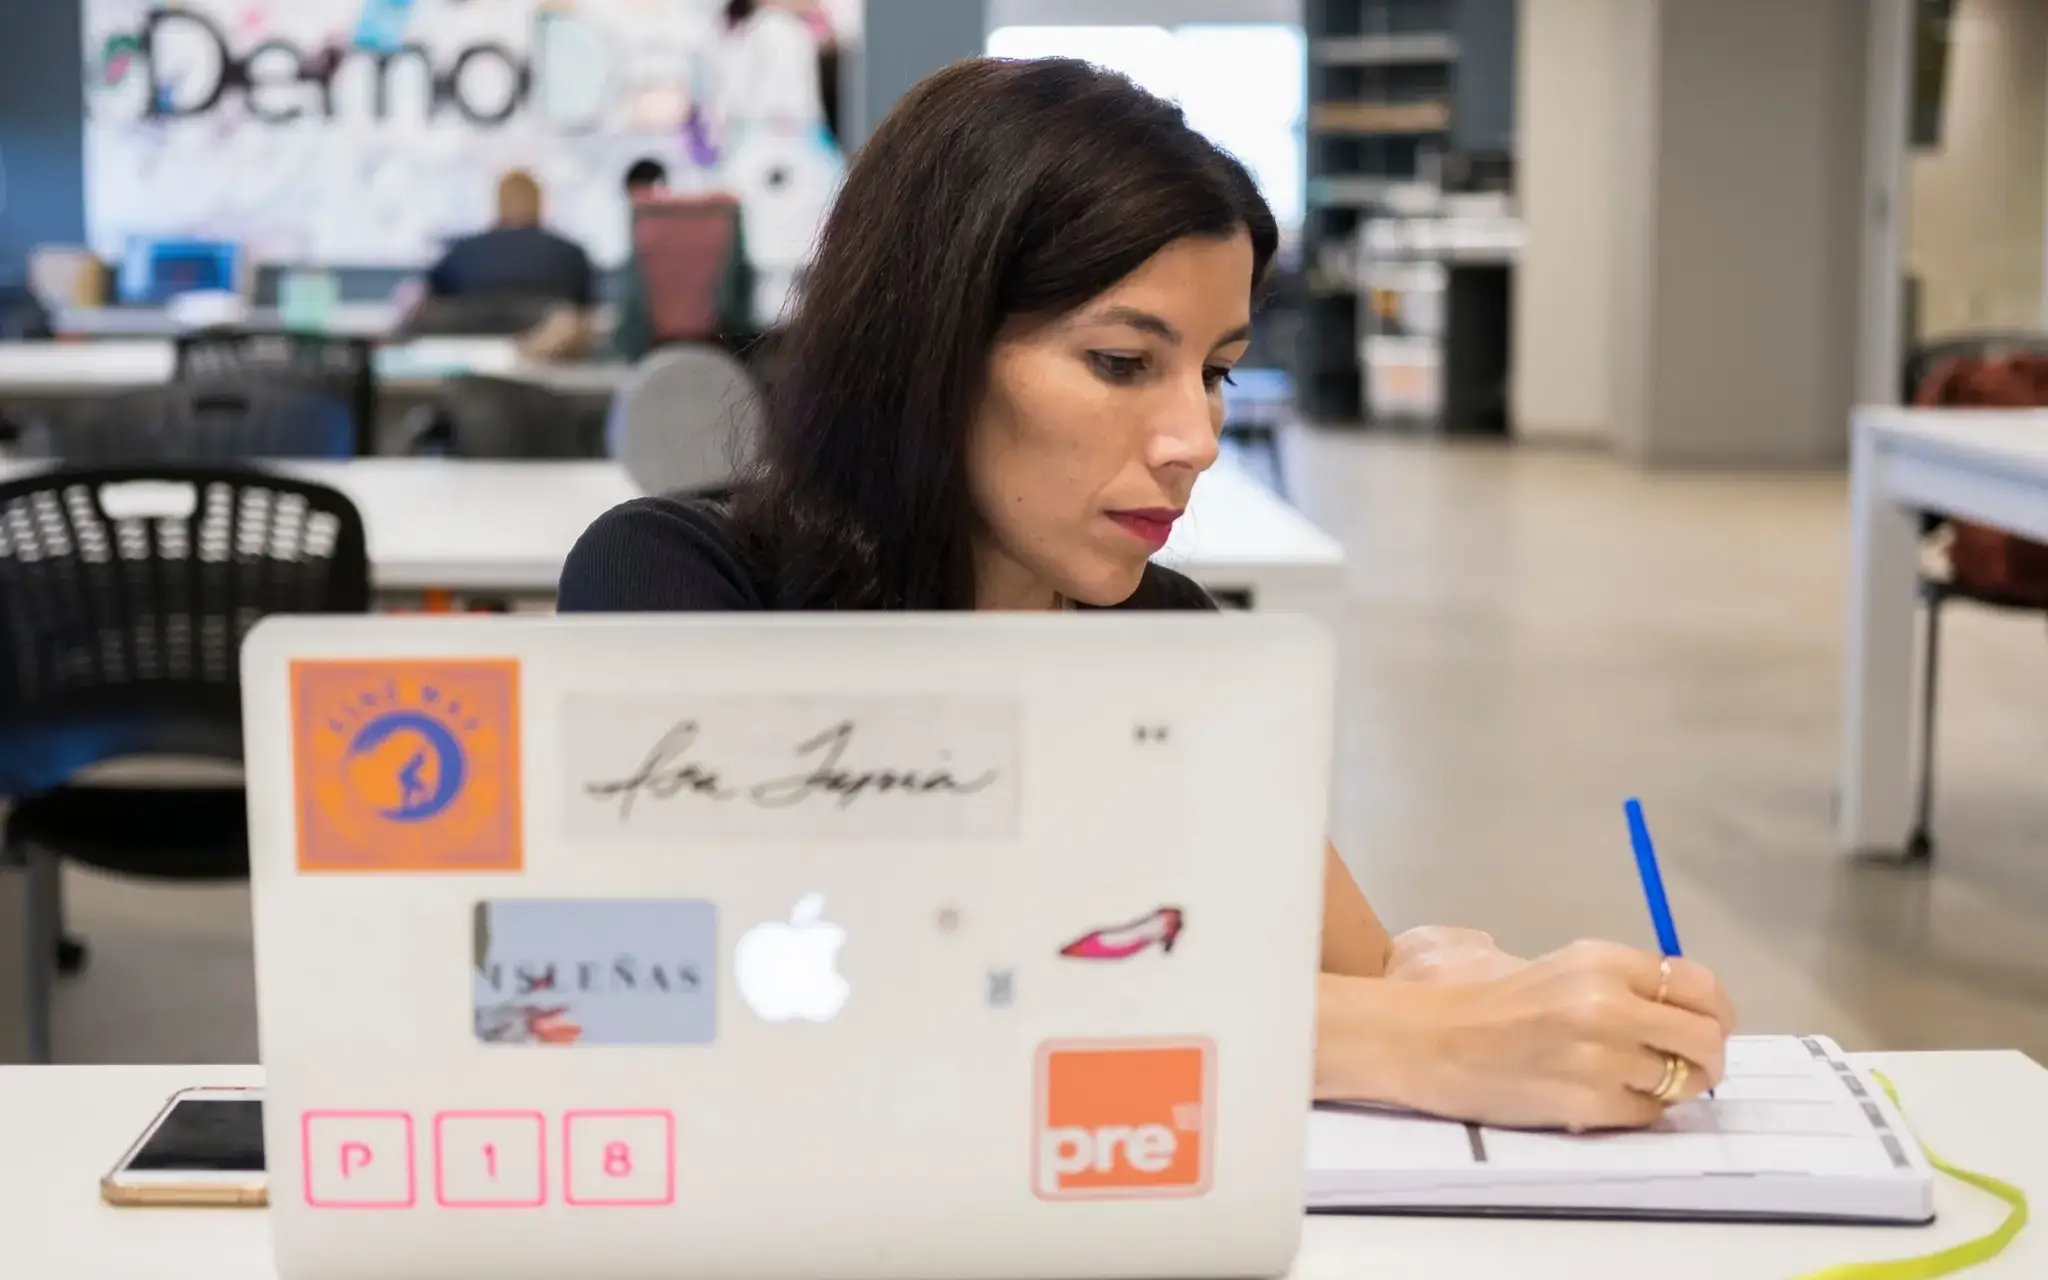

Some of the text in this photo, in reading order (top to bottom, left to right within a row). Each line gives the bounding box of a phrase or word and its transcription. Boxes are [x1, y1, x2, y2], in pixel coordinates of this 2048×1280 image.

[339, 1141, 374, 1180] P
[603, 1140, 632, 1179] 8
[1041, 1123, 1177, 1191] pre
